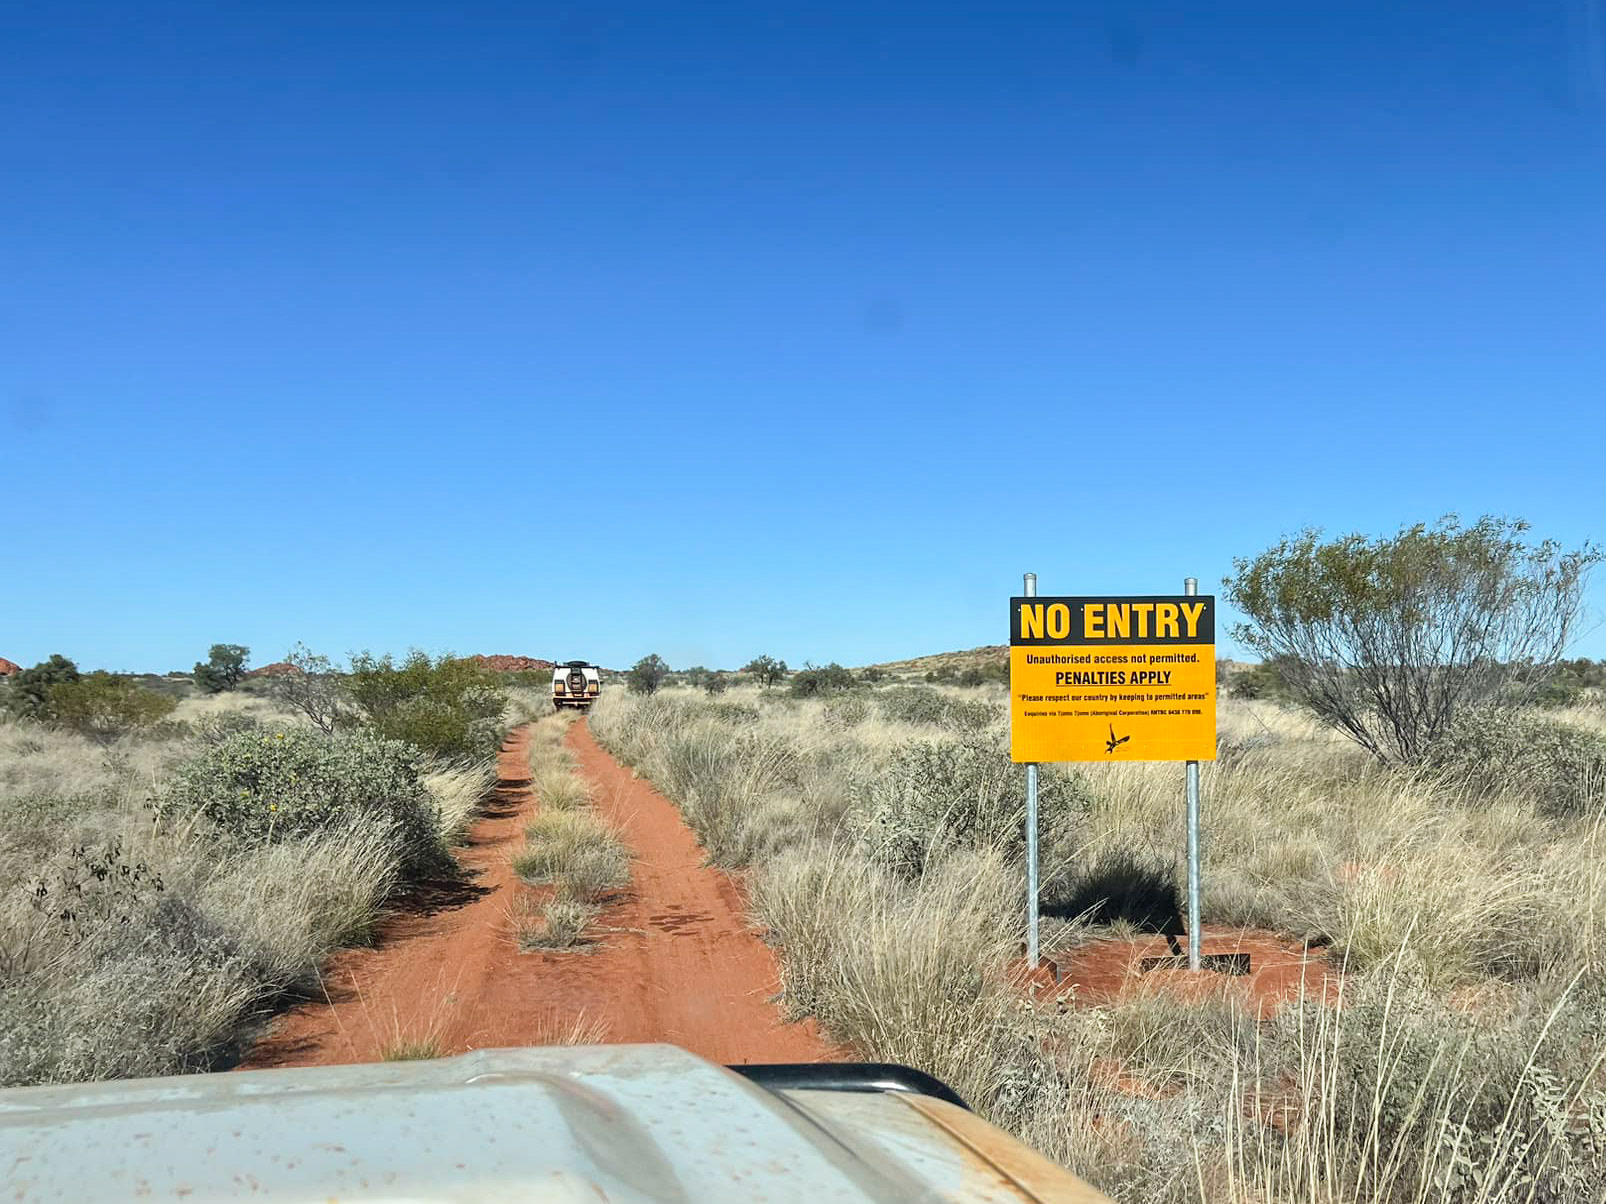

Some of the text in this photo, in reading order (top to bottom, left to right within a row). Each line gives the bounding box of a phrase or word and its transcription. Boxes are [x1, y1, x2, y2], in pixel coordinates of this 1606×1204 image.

[1020, 602, 1205, 639] NO ENTRY
[1026, 653, 1200, 666] Unauthorised access not permitted.
[1055, 671, 1171, 684] PENALTIES APPLY
[1018, 691, 1209, 703] "Please respect our country by keeping to permitted areas"
